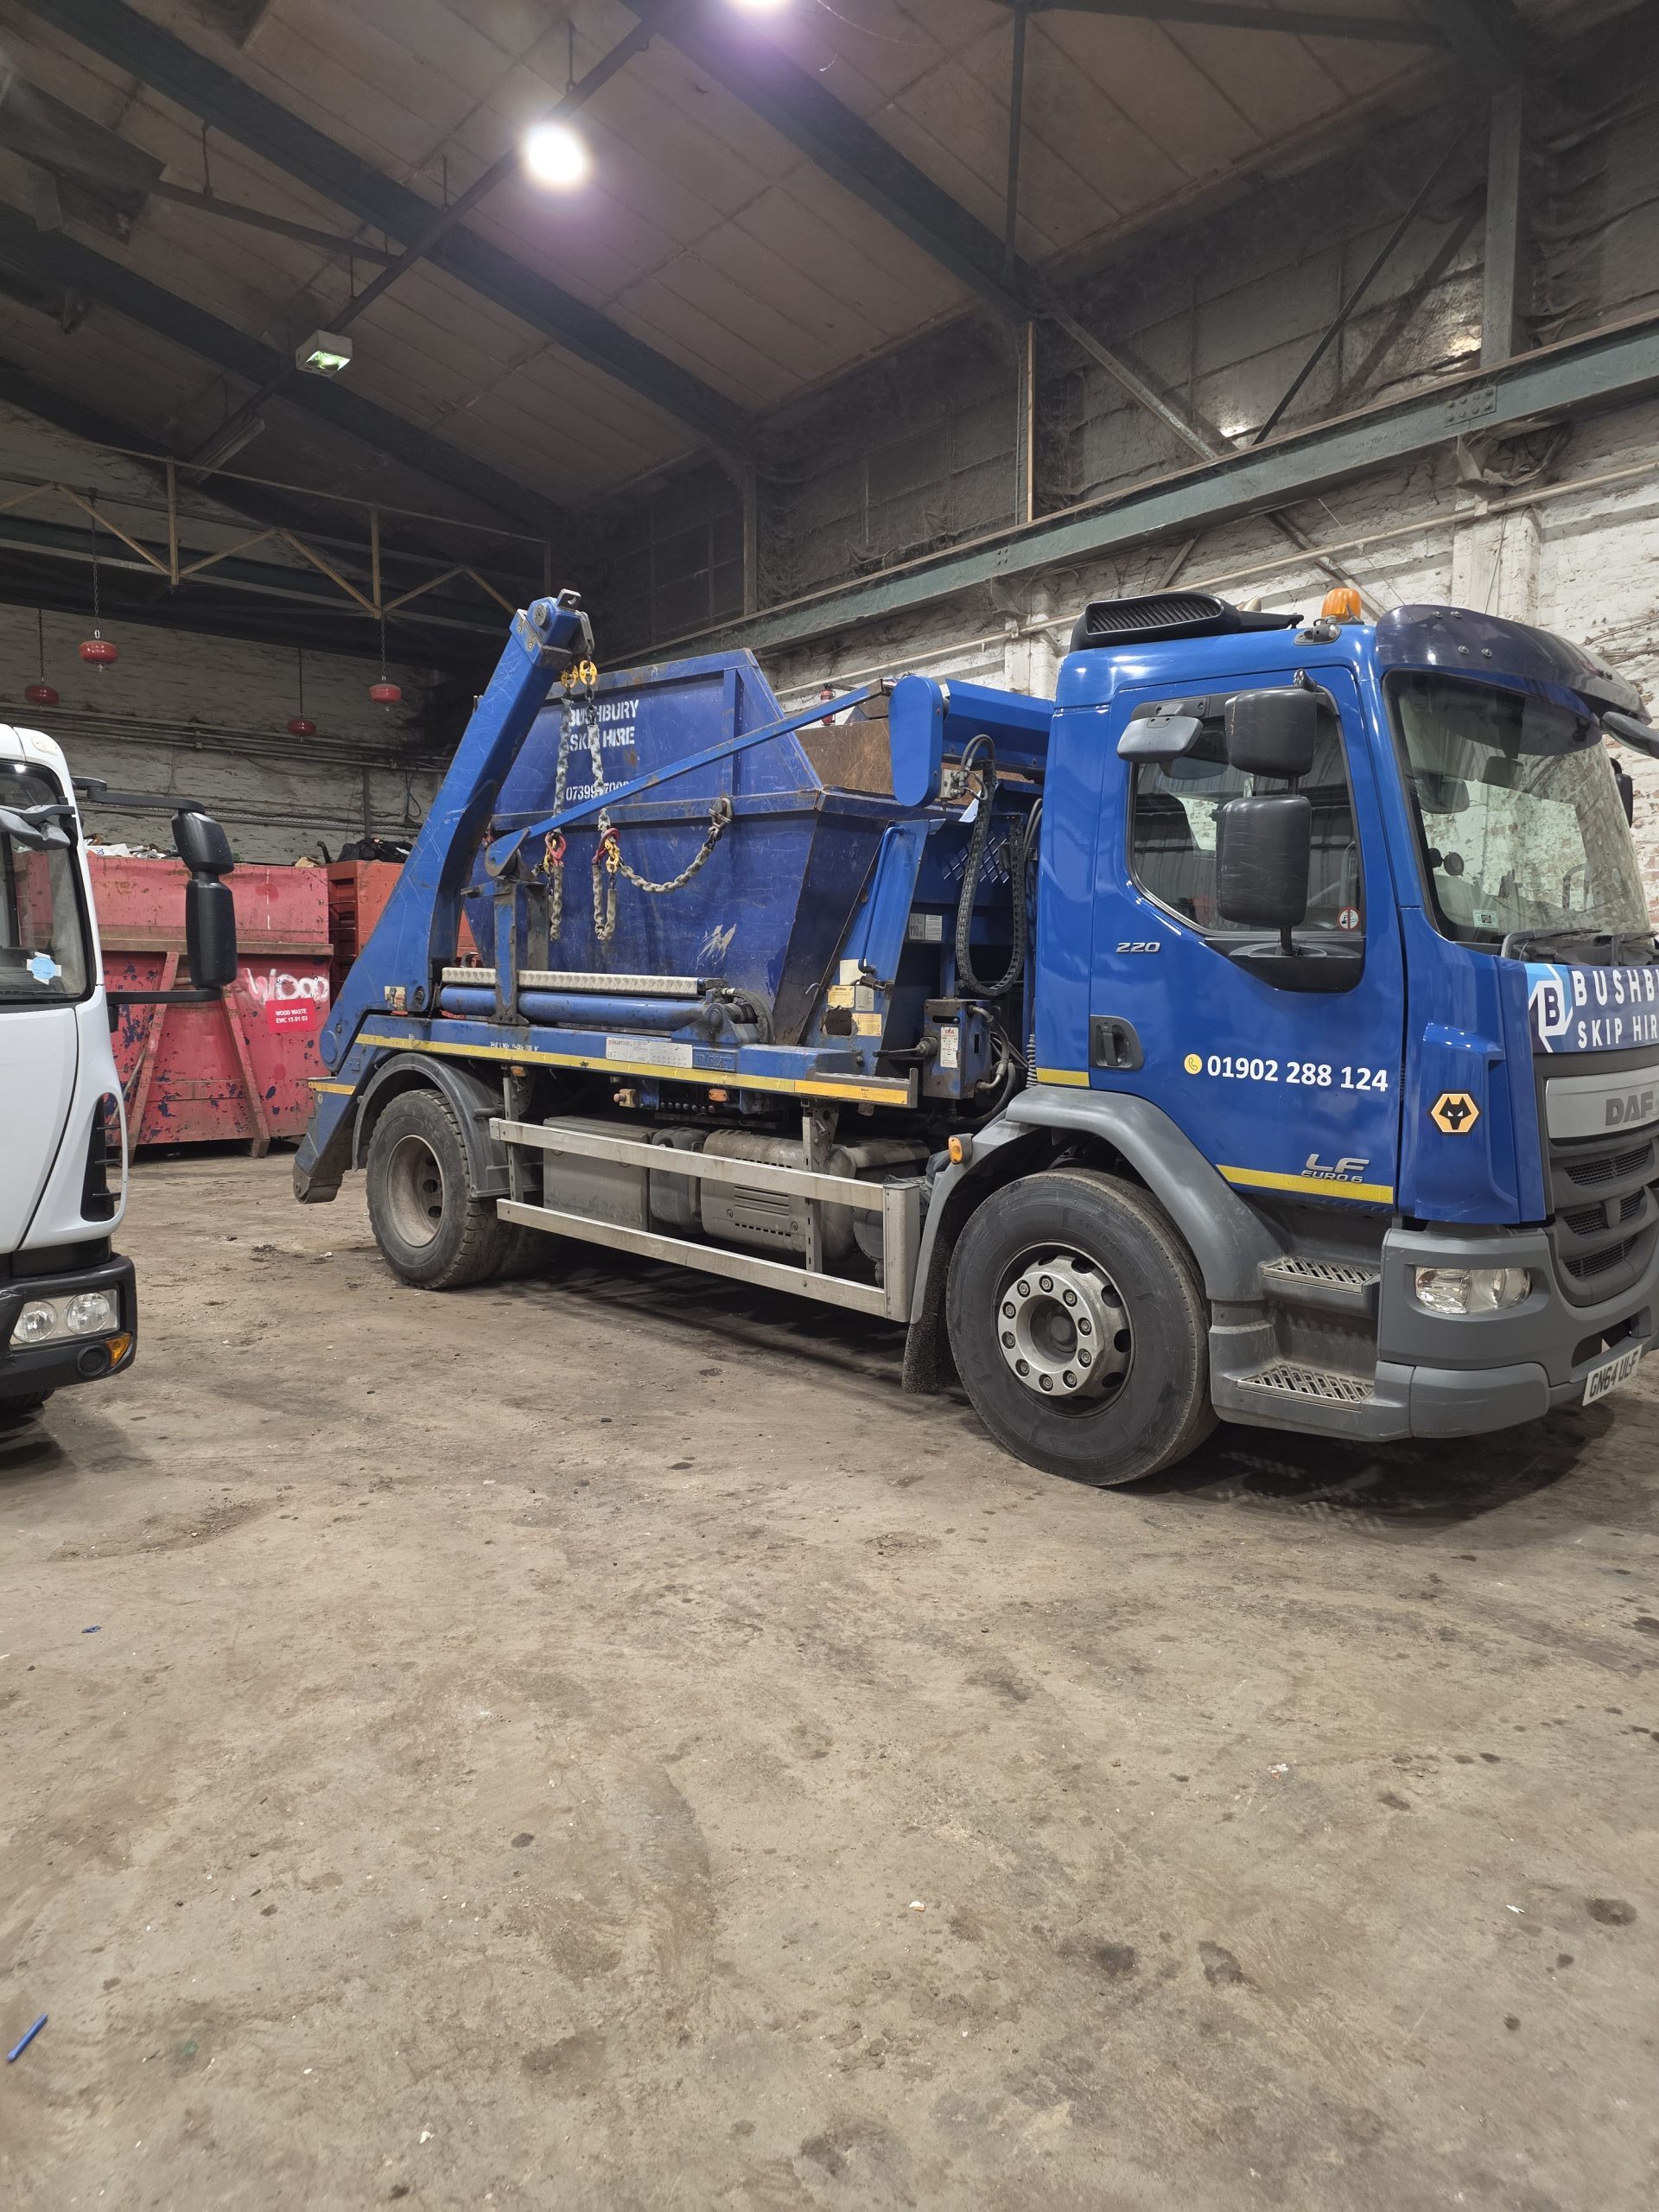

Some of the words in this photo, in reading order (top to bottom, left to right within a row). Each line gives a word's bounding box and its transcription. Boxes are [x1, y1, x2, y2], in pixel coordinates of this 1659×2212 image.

[602, 727, 635, 747] HIRE
[1116, 942, 1160, 953] 220
[1571, 969, 1659, 1007] BUSHB
[1577, 1017, 1623, 1049] SKIP
[1207, 1055, 1278, 1082] 01902
[1286, 1061, 1332, 1086] 288
[1340, 1066, 1389, 1092] 124
[1605, 1090, 1654, 1127] DAF
[1300, 1169, 1349, 1181] EURO
[1306, 1154, 1370, 1173] LF
[1589, 1362, 1618, 1397] GN64
